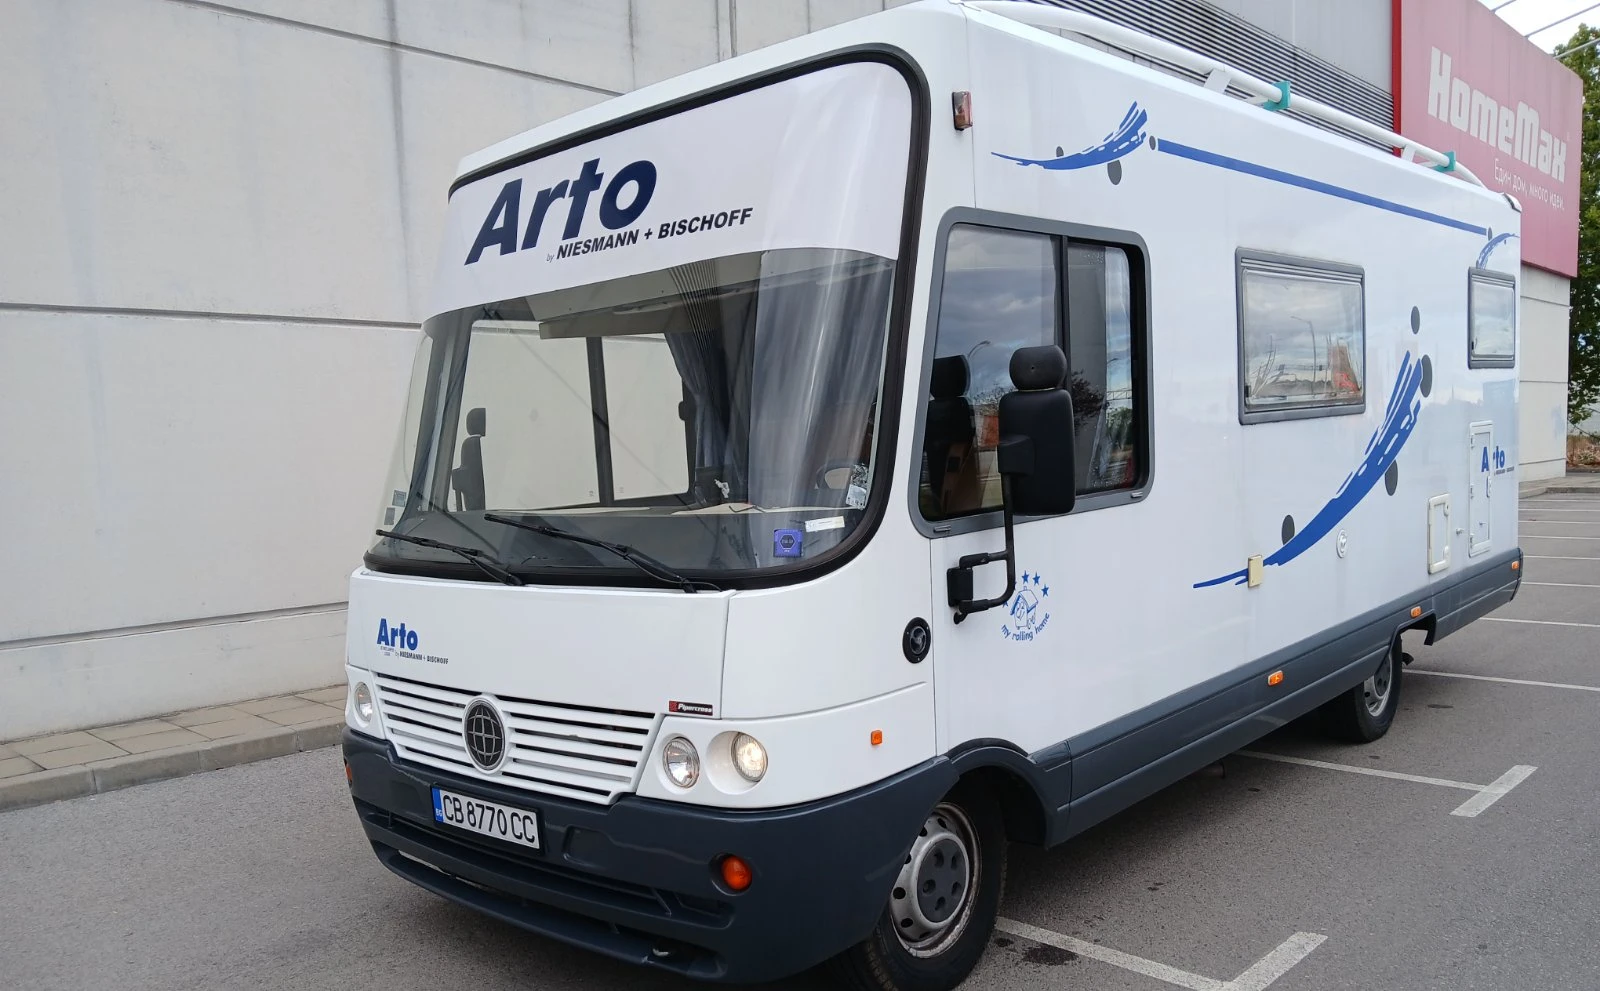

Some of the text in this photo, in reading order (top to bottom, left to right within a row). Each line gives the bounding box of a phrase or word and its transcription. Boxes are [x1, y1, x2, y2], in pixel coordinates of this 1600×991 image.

[1428, 46, 1566, 183] HomeMax
[464, 158, 656, 265] Arto
[556, 229, 639, 260] NIESMANN
[657, 207, 753, 239] BISCHOFF
[376, 618, 418, 651] Arto
[1001, 612, 1050, 641] my rolling home
[678, 703, 712, 712] Pipercross
